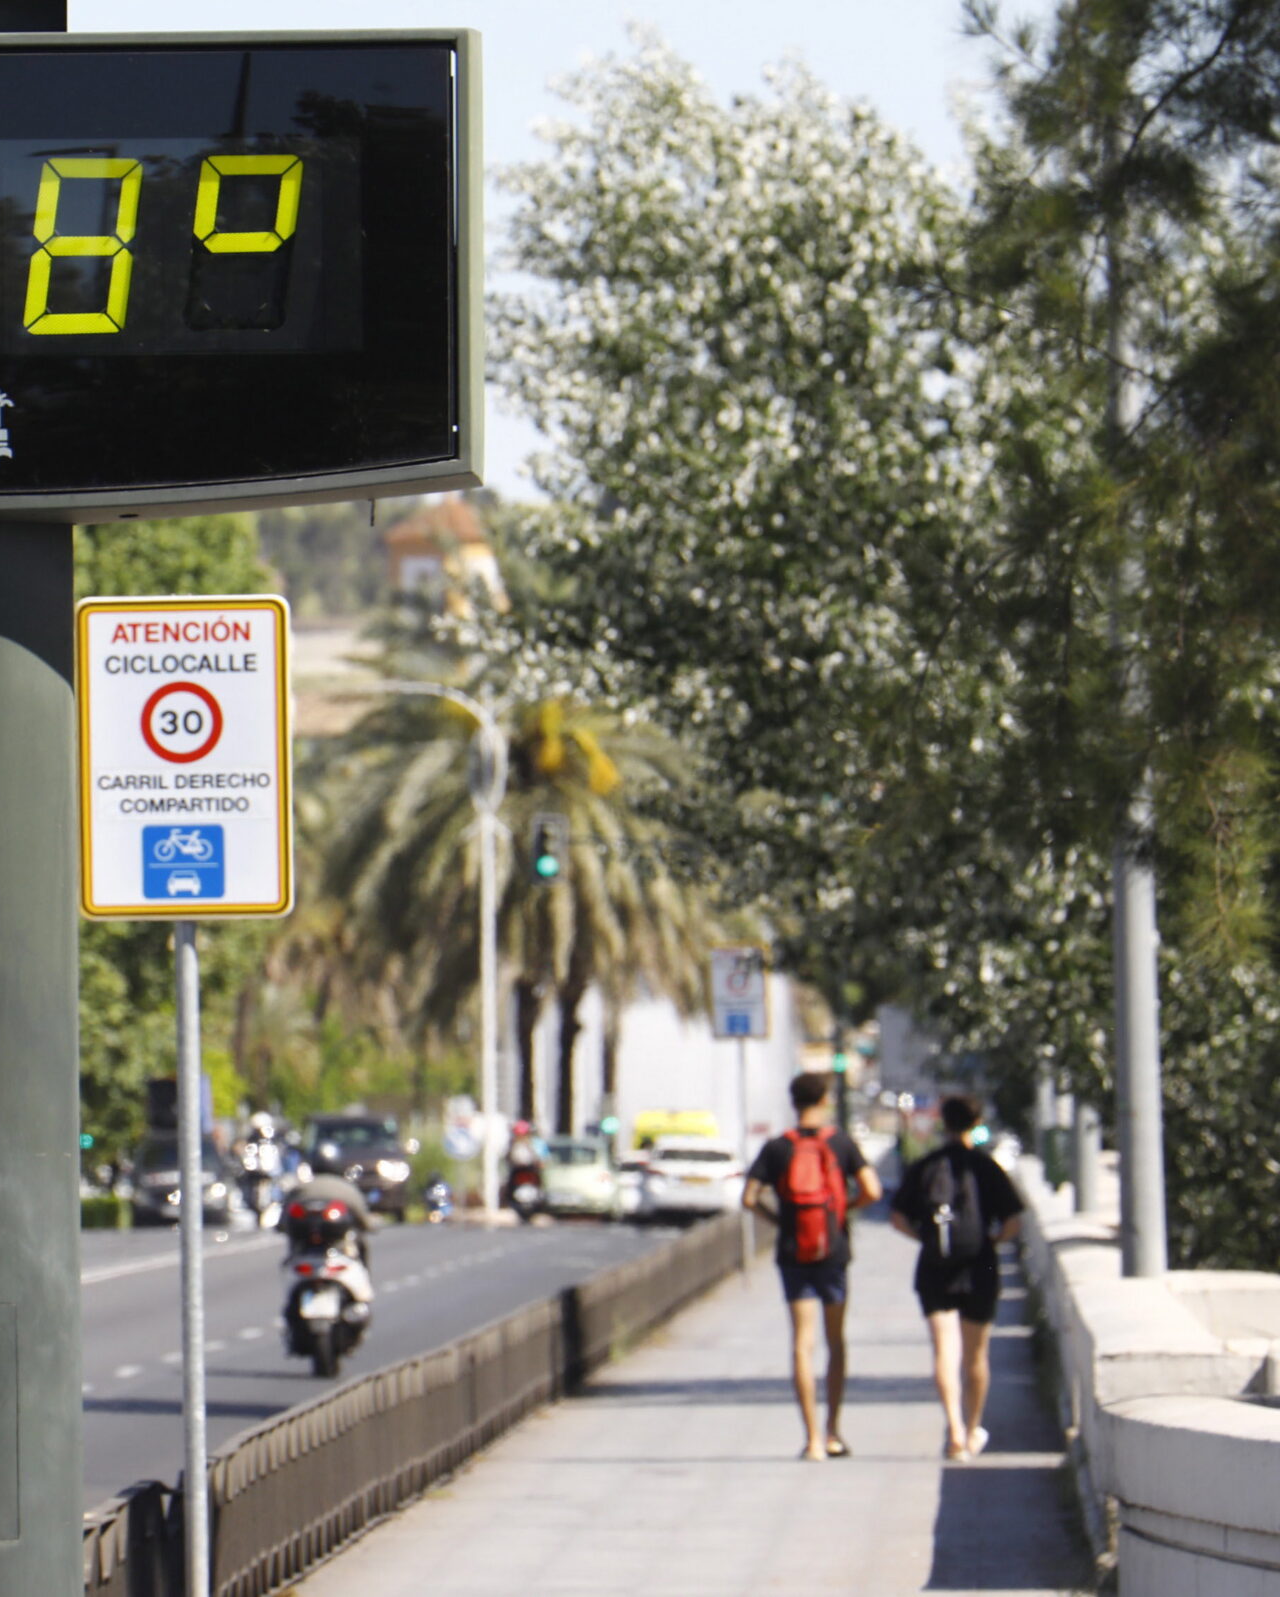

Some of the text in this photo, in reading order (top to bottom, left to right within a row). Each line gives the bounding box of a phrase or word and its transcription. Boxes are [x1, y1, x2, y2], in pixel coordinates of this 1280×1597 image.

[111, 615, 251, 643] ATENCIÓN
[104, 653, 257, 674] CICLOCALLE
[160, 710, 203, 735] 30
[97, 772, 271, 791] CARRIL DERECHO
[119, 796, 250, 814] COMPARTIDO
